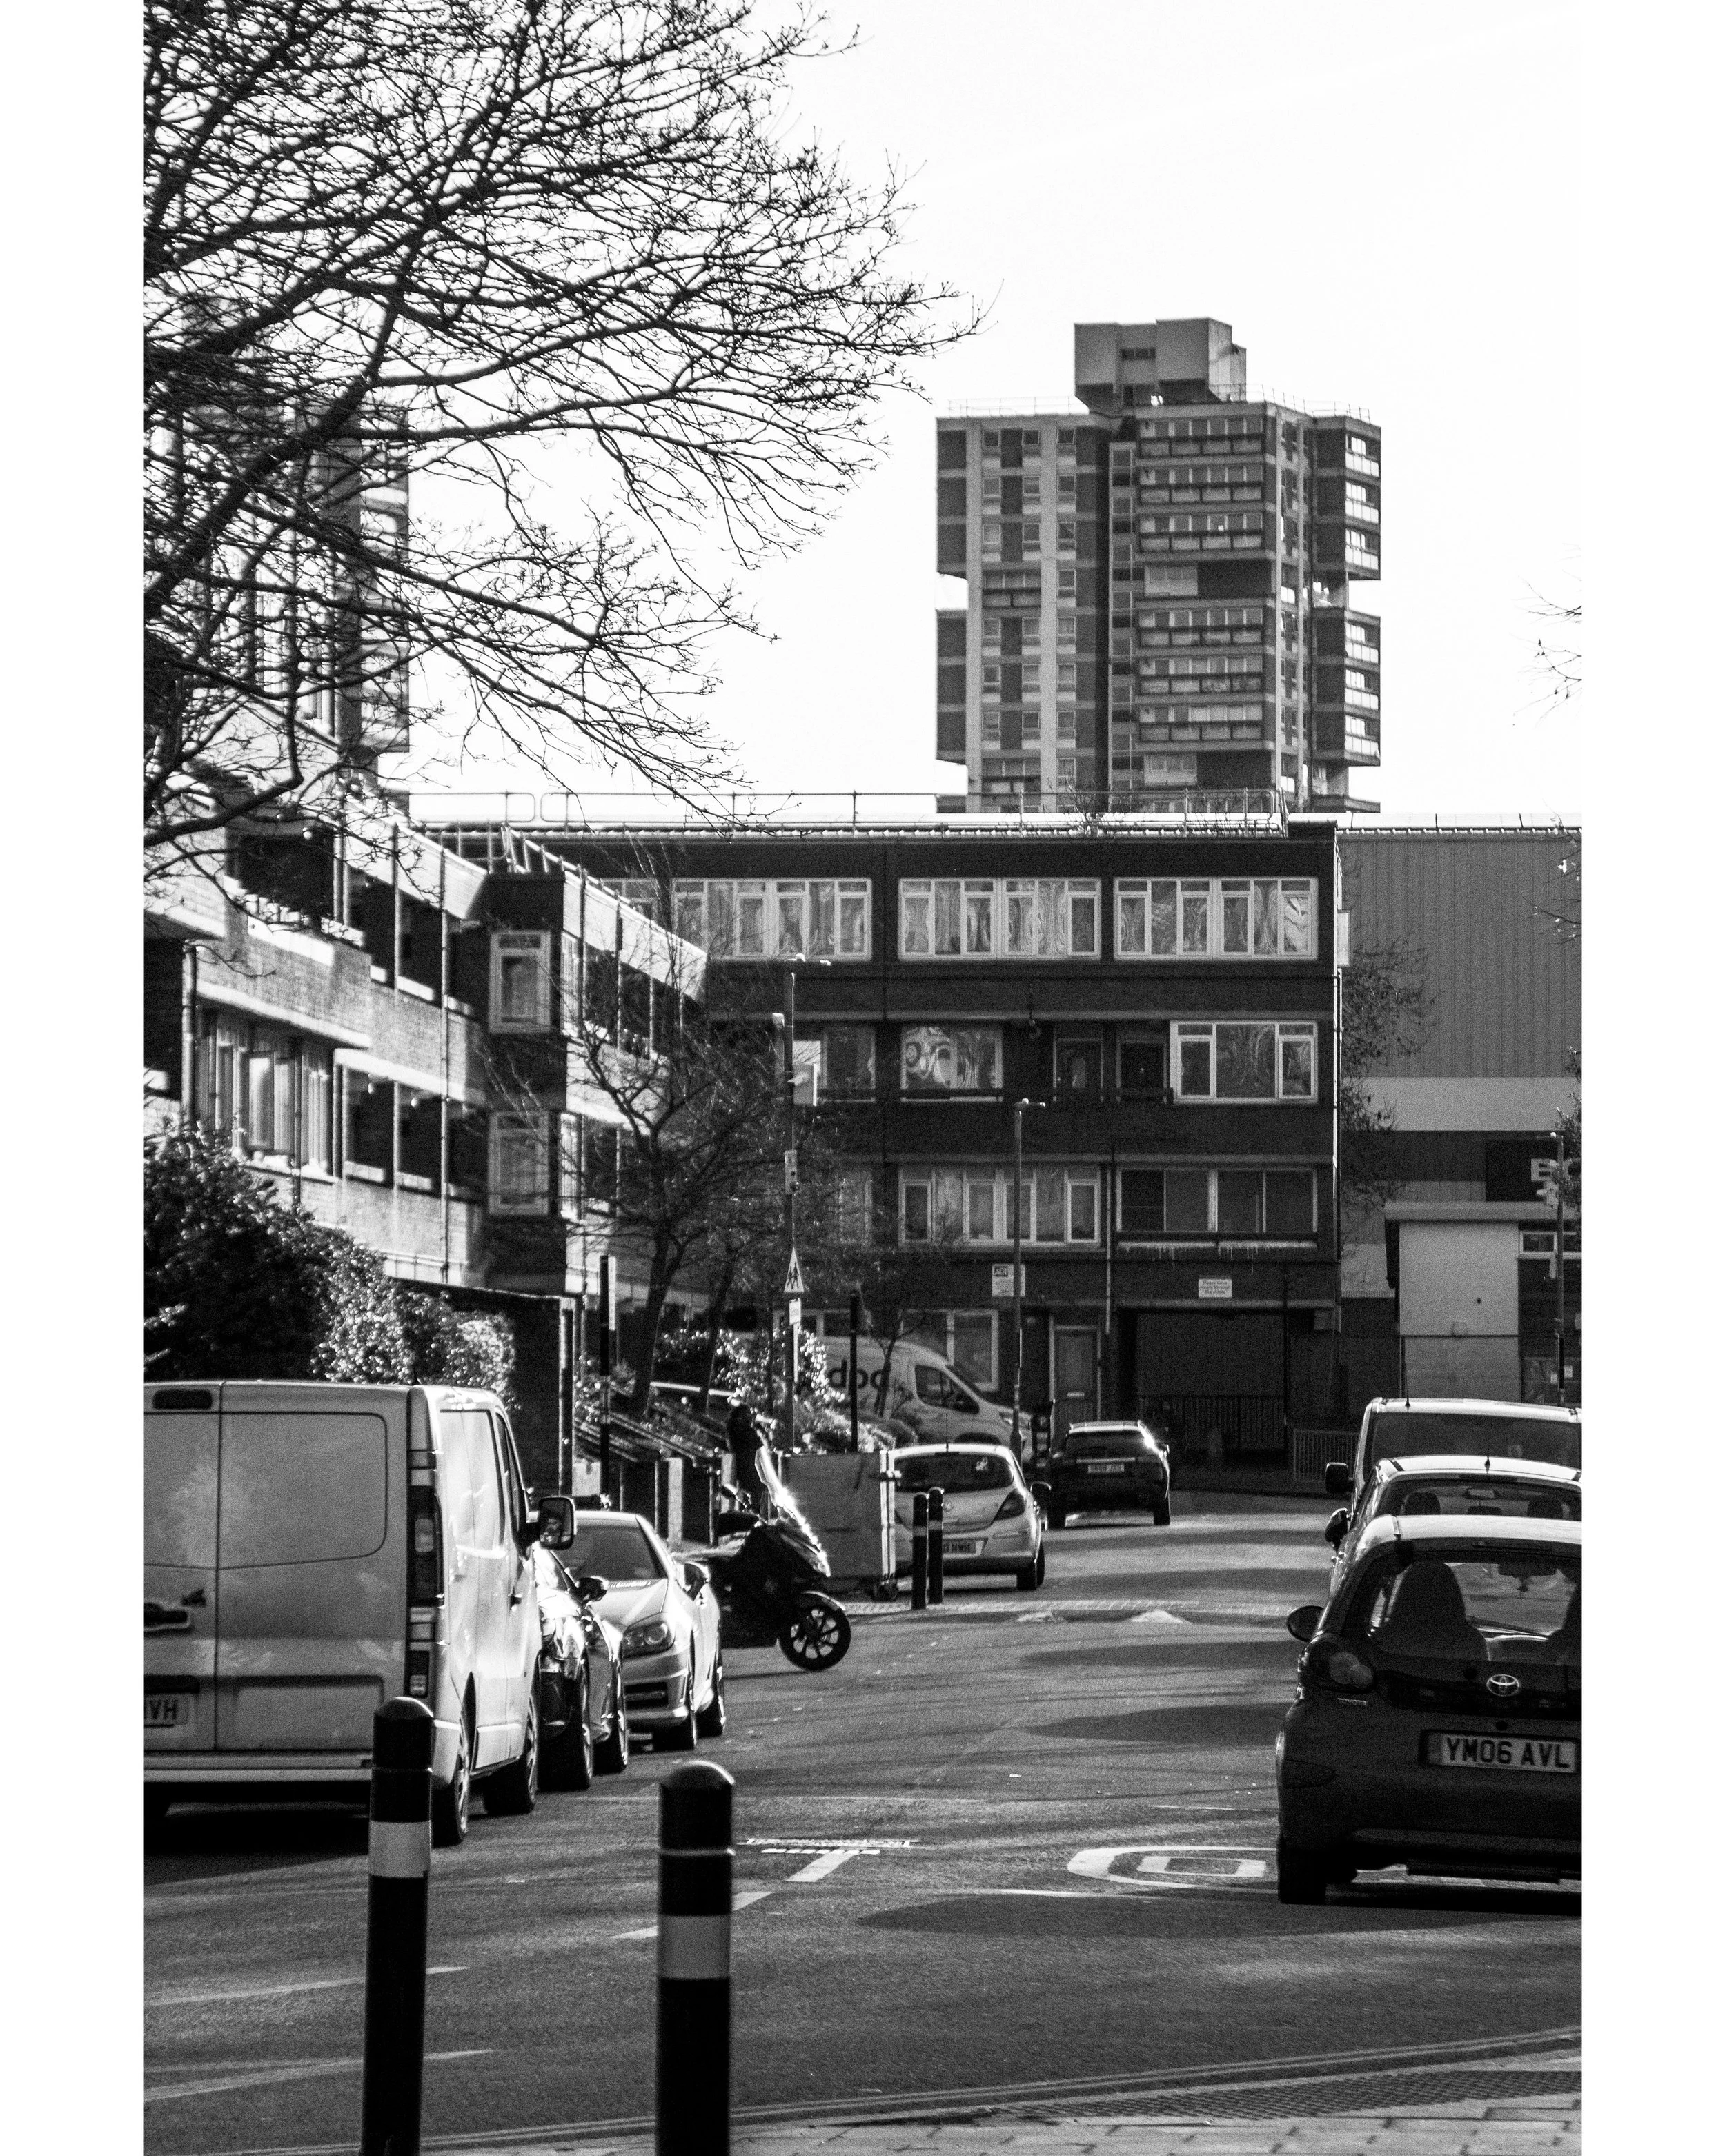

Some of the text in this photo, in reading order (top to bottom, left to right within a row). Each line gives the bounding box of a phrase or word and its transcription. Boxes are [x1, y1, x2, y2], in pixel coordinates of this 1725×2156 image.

[144, 1699, 177, 1719] VH
[1447, 1737, 1570, 1768] YM06 AVL
